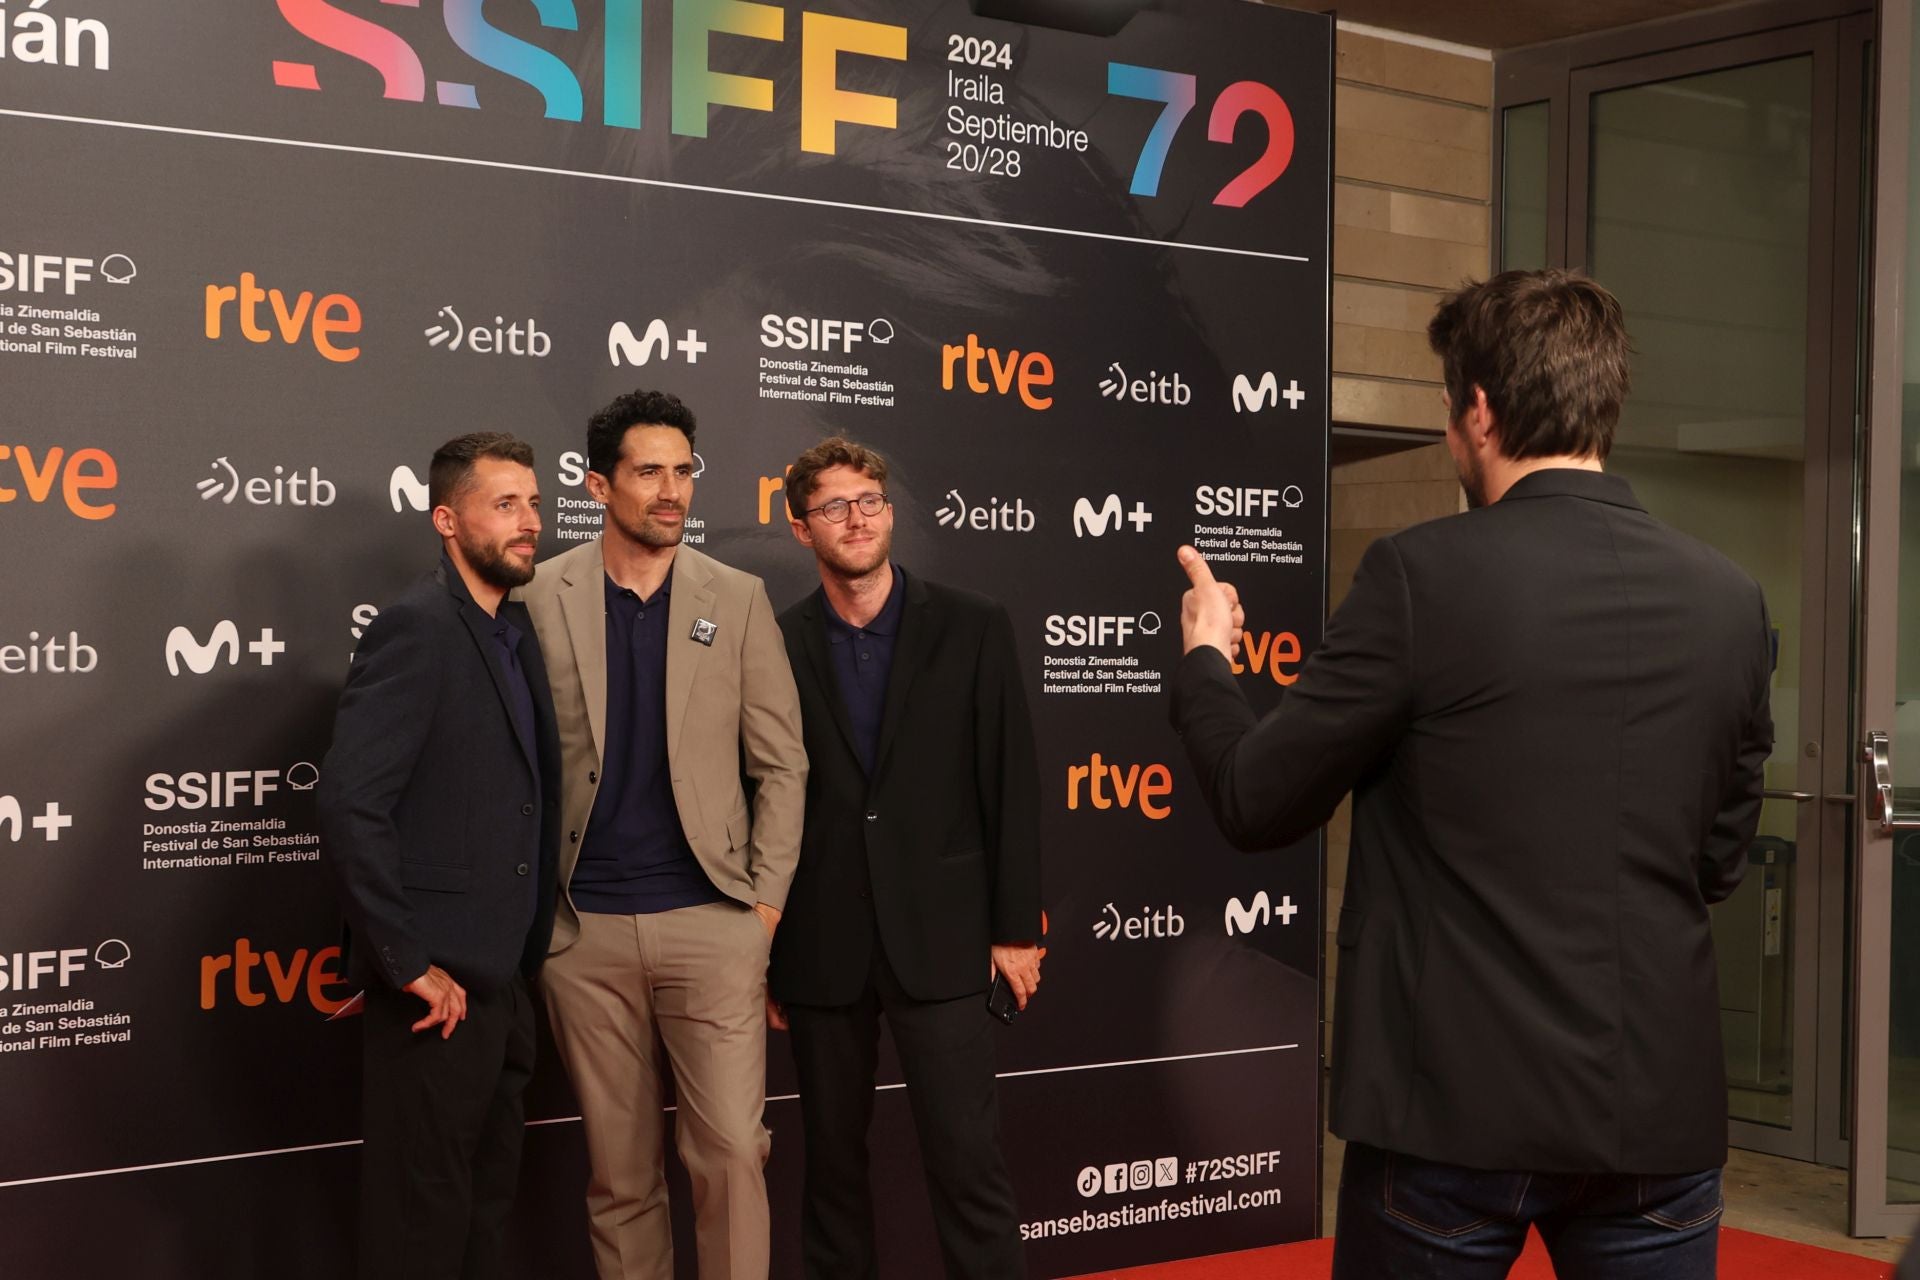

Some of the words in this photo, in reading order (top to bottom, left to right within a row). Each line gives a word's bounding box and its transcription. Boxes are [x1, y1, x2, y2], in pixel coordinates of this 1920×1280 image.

[947, 34, 1013, 70] 2024
[272, 0, 907, 156] SSIFF
[948, 69, 1005, 105] Iraila
[946, 105, 1089, 152] Septiembre
[946, 141, 1022, 178] 20/28
[18, 305, 101, 322] Zinemaldia
[205, 271, 362, 363] rtve
[8, 322, 28, 335] de
[31, 323, 60, 337] San
[63, 325, 137, 341] Sebastián
[468, 315, 551, 357] eitb
[760, 314, 864, 353] SSIFF
[45, 342, 77, 355] Film
[80, 343, 137, 358] Festival
[760, 357, 808, 371] Donostia
[810, 361, 869, 376] Zinemaldia
[760, 372, 801, 386] Festival
[803, 376, 818, 387] de
[819, 377, 841, 388] San
[842, 378, 894, 392] Sebastián
[942, 333, 1054, 410] rtve
[1130, 370, 1191, 405] eitb
[759, 387, 827, 402] International
[829, 392, 852, 404] Film
[854, 394, 895, 407] Festival
[244, 465, 336, 506] eitb
[1195, 485, 1279, 518] SSIFF
[557, 512, 603, 525] Festival
[969, 497, 1035, 532] eitb
[1194, 524, 1234, 535] Donostia
[1235, 526, 1282, 537] Zinemaldia
[1194, 537, 1228, 549] Festival
[1229, 539, 1241, 549] de
[1242, 540, 1260, 550] San
[1261, 540, 1303, 551] Sebastián
[1199, 551, 1249, 562] ternational
[1250, 552, 1269, 563] Film
[1270, 553, 1303, 564] Festival
[1044, 614, 1135, 647] SSIFF
[0, 631, 98, 674] eitb
[1044, 655, 1087, 666] Donostia
[1088, 655, 1139, 667] Zinemaldia
[1043, 683, 1103, 693] International
[1104, 683, 1125, 693] Film
[1126, 683, 1161, 693] Festival
[1044, 669, 1081, 680] Festival
[1082, 669, 1094, 680] de
[1096, 669, 1115, 680] San
[1116, 669, 1161, 680] Sebastián
[144, 770, 280, 811] SSIFF
[1067, 752, 1173, 820] rtve
[143, 821, 207, 836] Donostia
[210, 818, 287, 833] Zinemaldia
[143, 838, 198, 853] Festival
[201, 837, 219, 850] de
[222, 836, 249, 849] San
[252, 833, 320, 847] Sebastián
[143, 854, 232, 870] International
[235, 852, 265, 865] Film
[268, 849, 320, 863] Festival
[1124, 904, 1185, 940] eitb
[2, 1022, 21, 1035] de
[25, 1020, 54, 1032] San
[58, 1013, 131, 1030] Sebastián
[12, 999, 95, 1016] Zinemaldia
[39, 1035, 71, 1049] Film
[75, 1029, 131, 1046] Festival
[1185, 1150, 1281, 1184] #72SSIFF
[1019, 1187, 1282, 1241] sansebastianfestival.com
